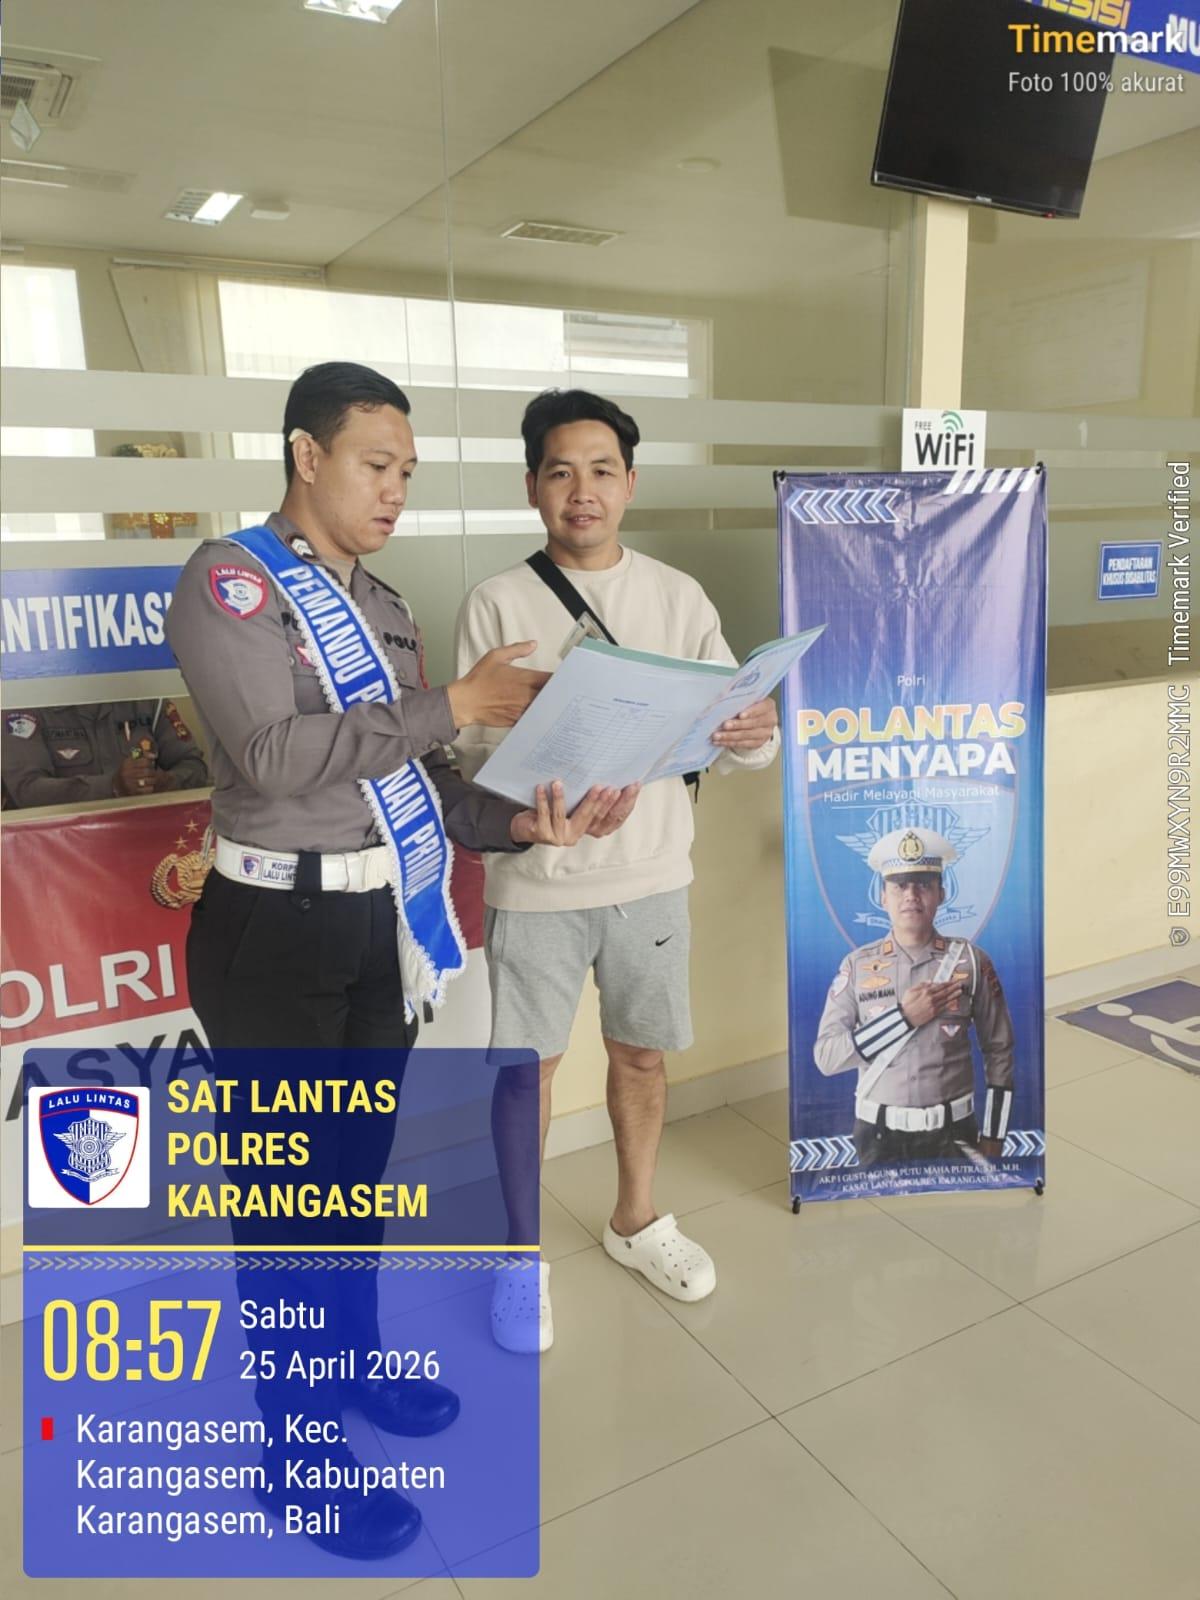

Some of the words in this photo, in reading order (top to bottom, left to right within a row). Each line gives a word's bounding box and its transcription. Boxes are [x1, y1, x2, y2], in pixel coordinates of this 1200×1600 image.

[915, 420, 932, 430] FREE
[915, 432, 975, 466] WiFi
[0, 592, 173, 654] NTIFIKAS
[897, 674, 926, 687] Polri
[277, 565, 377, 686] PEMANDU
[401, 820, 444, 905] PRIMA
[797, 701, 1027, 746] POLANTAS
[807, 742, 1016, 783] MENYAPA
[823, 791, 859, 803] Hadir
[863, 787, 922, 801] Melayani
[925, 785, 1000, 799] Masyarakat
[263, 869, 281, 880] LALU
[819, 1175, 836, 1185] AKP
[899, 1167, 922, 1177] PUTU
[923, 1165, 950, 1175] MAHA
